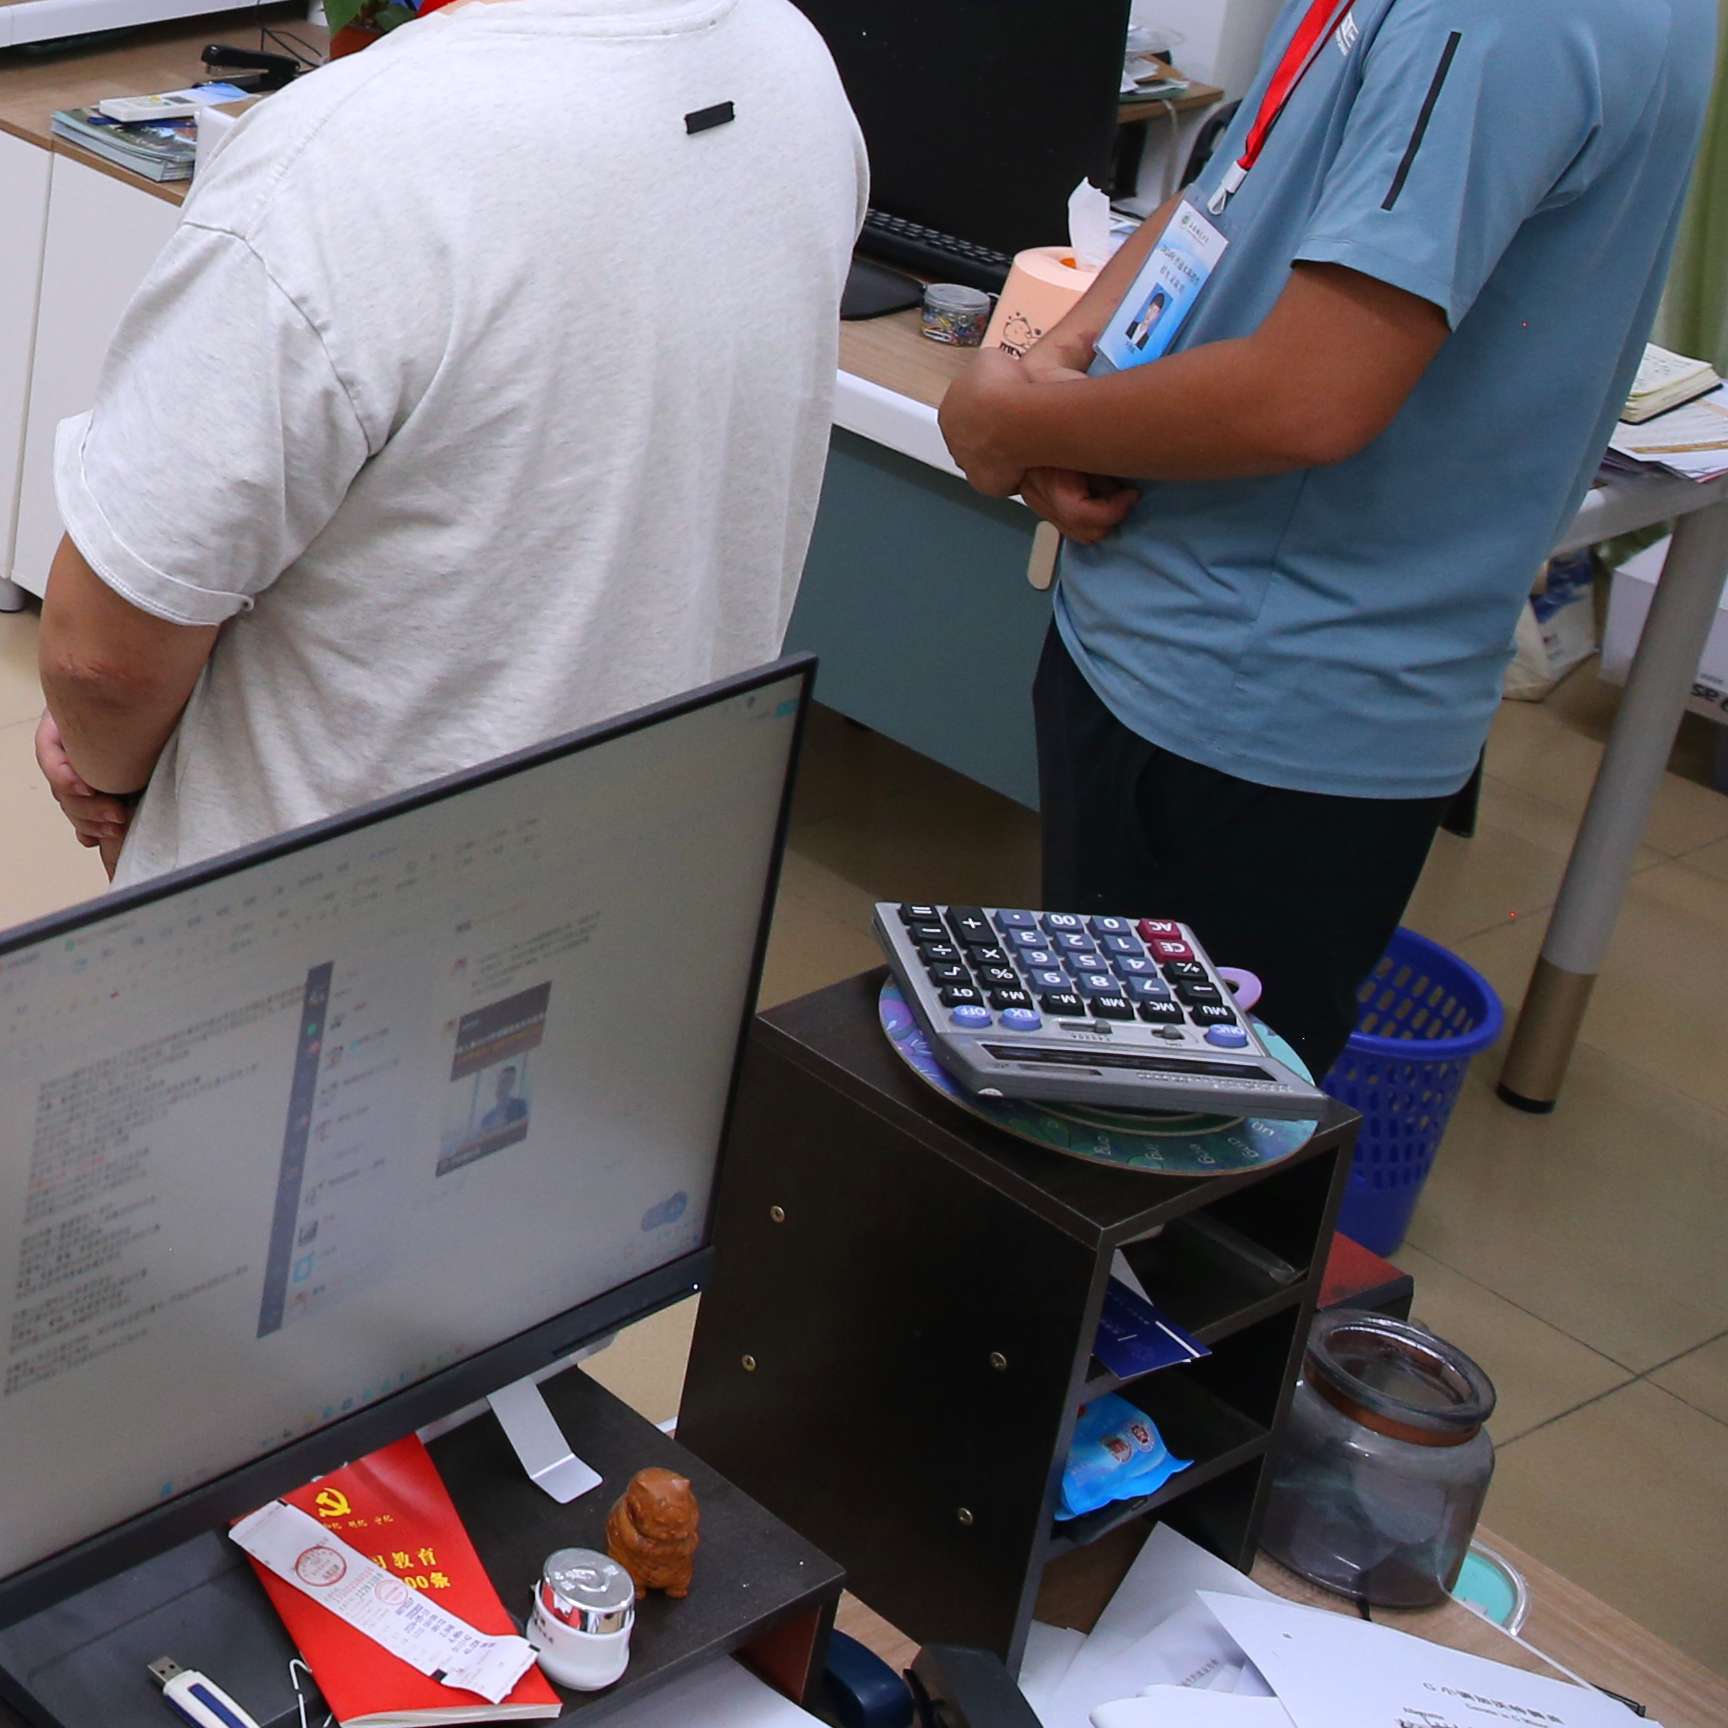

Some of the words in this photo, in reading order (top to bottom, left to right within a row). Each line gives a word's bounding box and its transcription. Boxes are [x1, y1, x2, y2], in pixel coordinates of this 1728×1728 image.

[1051, 914, 1076, 926] 00
[1103, 918, 1119, 929] 0
[1149, 921, 1172, 932] AC
[1020, 932, 1037, 943] 3
[1069, 935, 1084, 946] 2
[1118, 938, 1130, 949] 1
[1162, 942, 1186, 953] CE
[1032, 951, 1048, 963] 6
[1080, 955, 1098, 967] 5
[1127, 958, 1145, 969] 4
[1044, 972, 1061, 984] 9
[1090, 976, 1110, 987] 8
[1143, 979, 1160, 991] 7
[952, 988, 974, 998] GT
[1100, 997, 1126, 1008] MR
[1150, 1001, 1175, 1012] MC
[1202, 1005, 1228, 1016] MU
